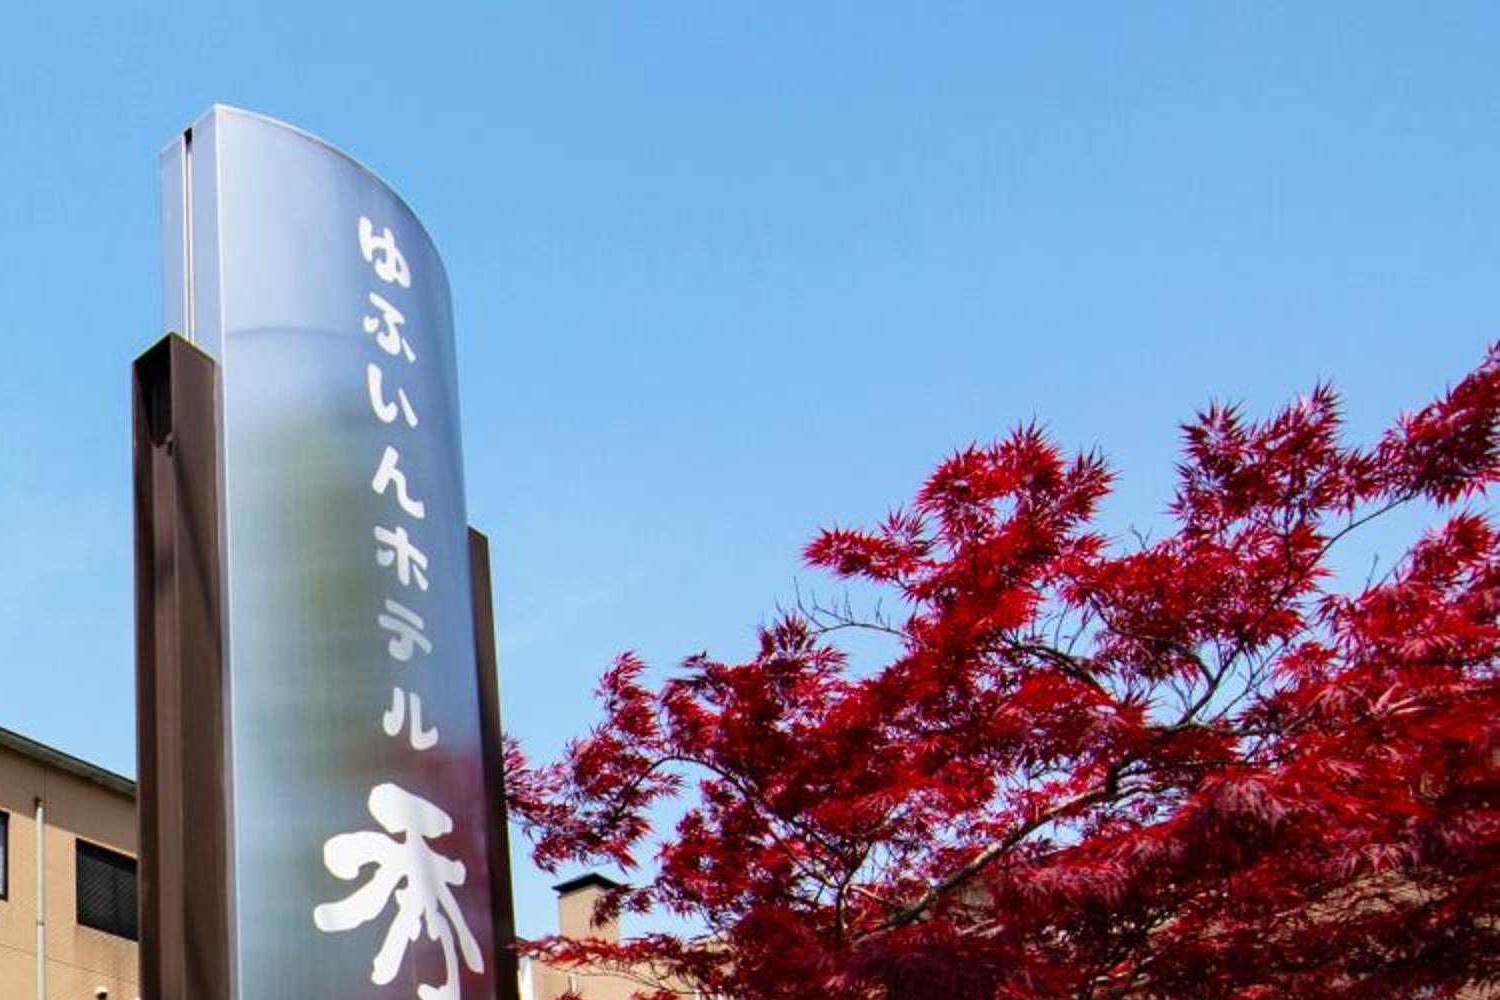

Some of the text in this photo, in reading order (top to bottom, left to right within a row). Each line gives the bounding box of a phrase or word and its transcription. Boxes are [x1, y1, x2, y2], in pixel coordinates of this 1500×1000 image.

[358, 216, 439, 752] ゆふいんホテル
